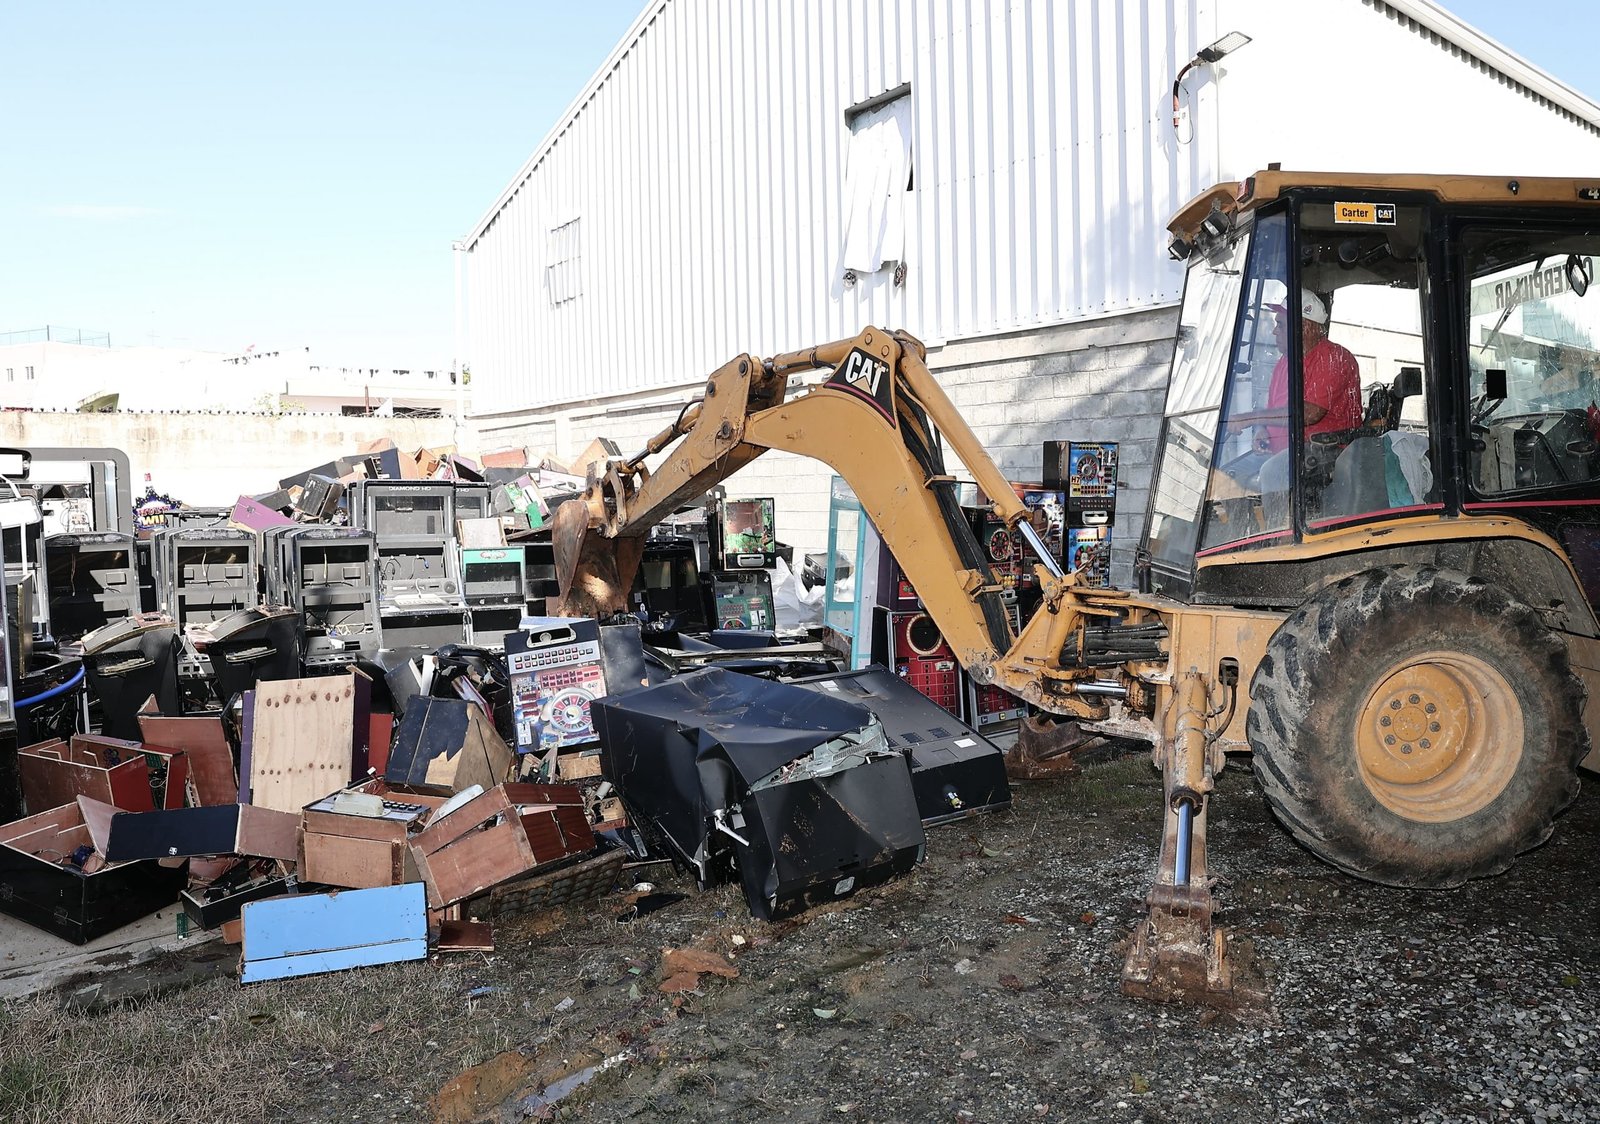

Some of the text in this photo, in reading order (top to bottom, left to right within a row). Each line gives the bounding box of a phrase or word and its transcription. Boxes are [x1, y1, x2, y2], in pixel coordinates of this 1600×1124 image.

[1341, 207, 1393, 219] Carter CAT
[845, 351, 886, 397] CAT
